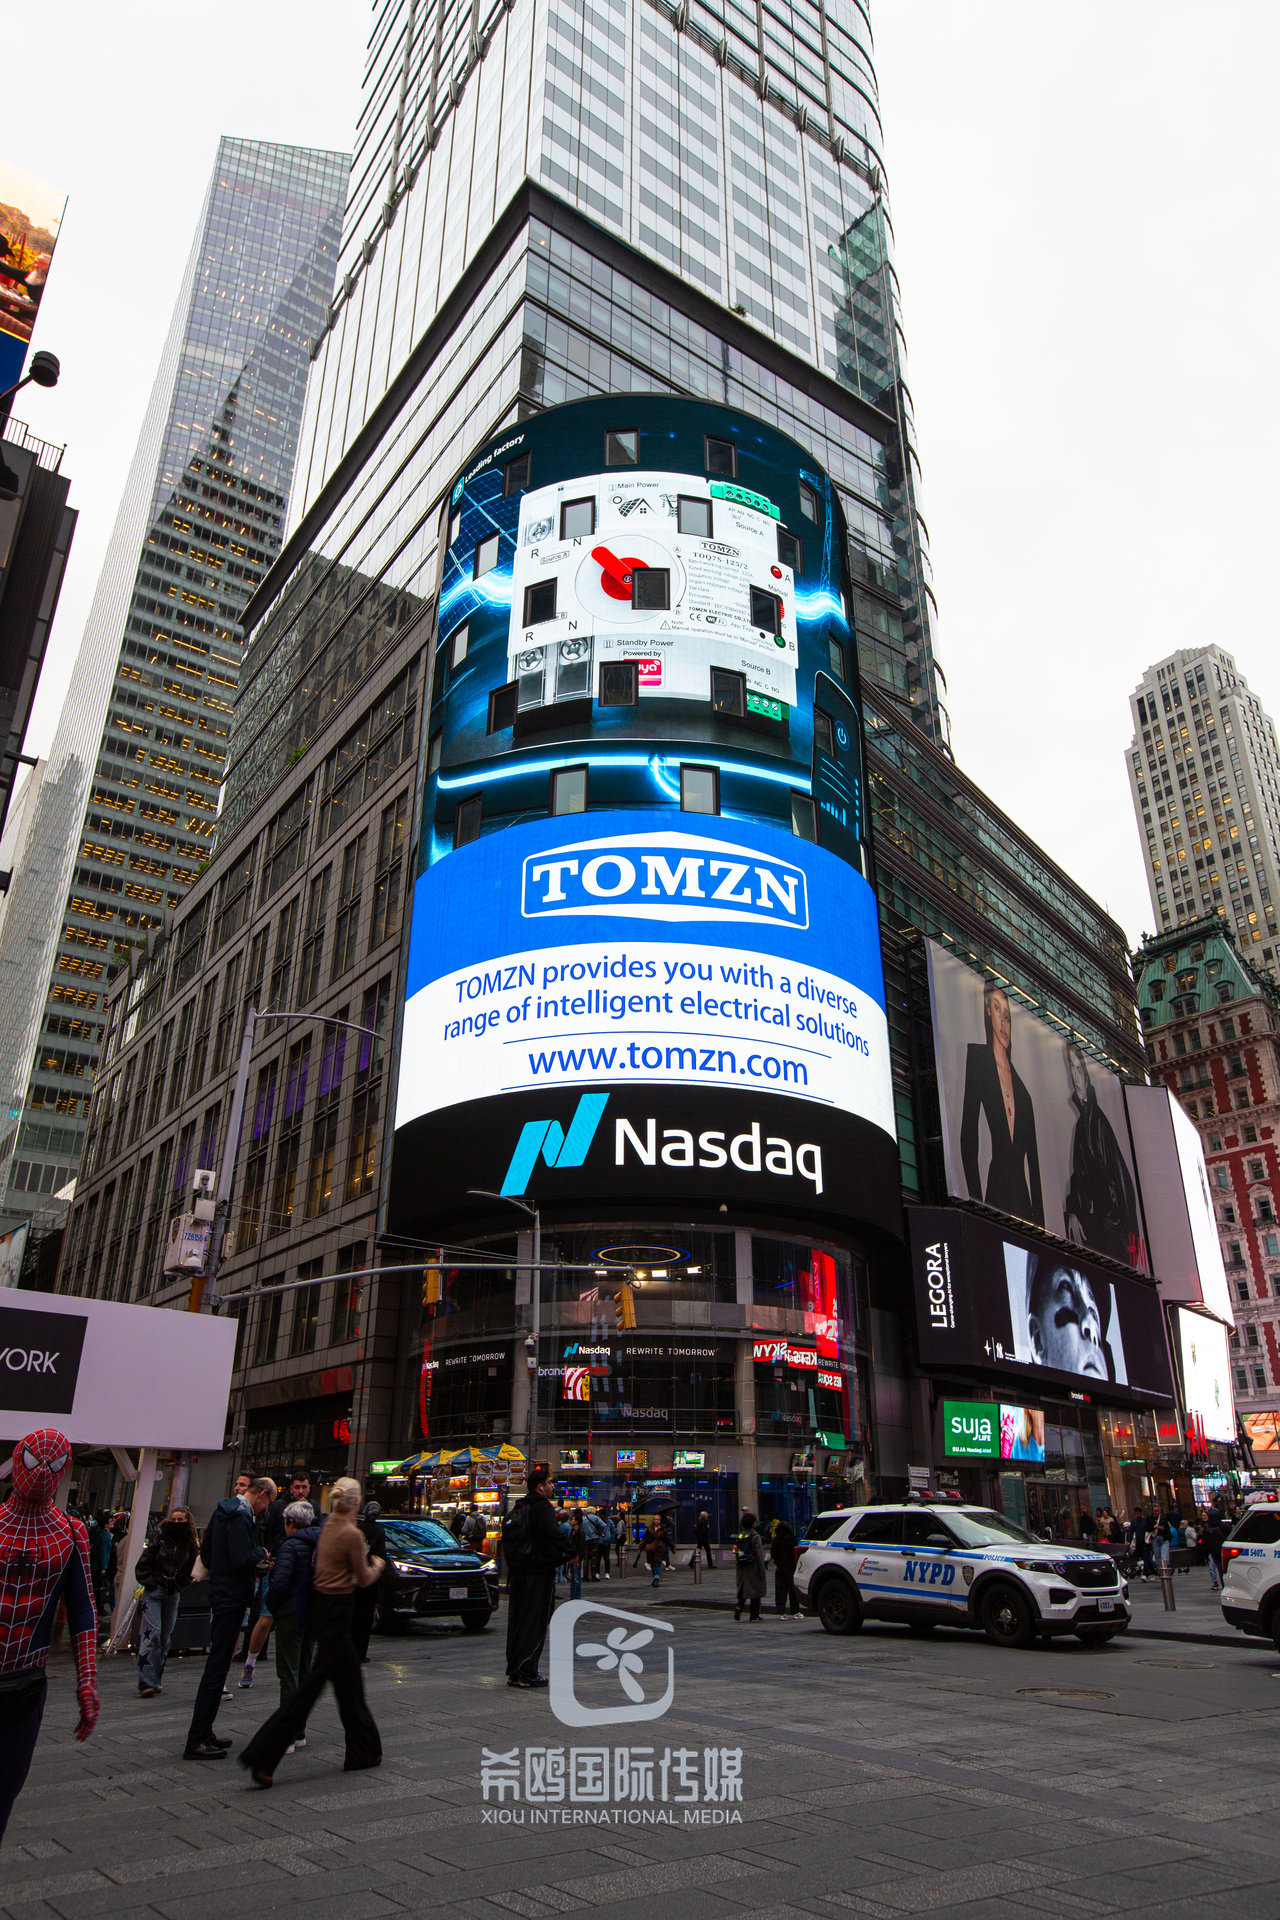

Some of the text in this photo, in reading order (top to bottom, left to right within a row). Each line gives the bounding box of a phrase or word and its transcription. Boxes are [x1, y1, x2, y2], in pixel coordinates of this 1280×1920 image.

[465, 434, 524, 484] Leading factory
[736, 521, 758, 535] Source
[573, 537, 582, 547] N
[701, 542, 740, 556] TOMZN
[531, 549, 539, 558] R
[542, 554, 561, 564] Source
[785, 574, 792, 584] A
[768, 584, 789, 597] Manual
[708, 610, 733, 619] ELECTRIC
[569, 620, 578, 630] N
[526, 632, 534, 642] R
[789, 642, 795, 651] B
[741, 660, 764, 674] Source
[532, 855, 798, 915] TOMZN
[456, 954, 858, 1019] TOMZN provides you with a diverse
[444, 990, 870, 1056] range of intelligent electrical solutions
[528, 1042, 808, 1086] www.tomzn.com
[615, 1118, 823, 1195] Nasdaq
[925, 1243, 948, 1327] LEGORA
[578, 1346, 610, 1356] Nasdaq
[626, 1347, 715, 1356] REWRITE TOMORROW
[446, 1352, 506, 1366] REWRITE TOMORROW
[818, 1359, 838, 1368] REWRITE
[623, 1406, 668, 1420] Nasdaq
[952, 1417, 992, 1440] suja
[904, 1560, 955, 1585] NYPD
